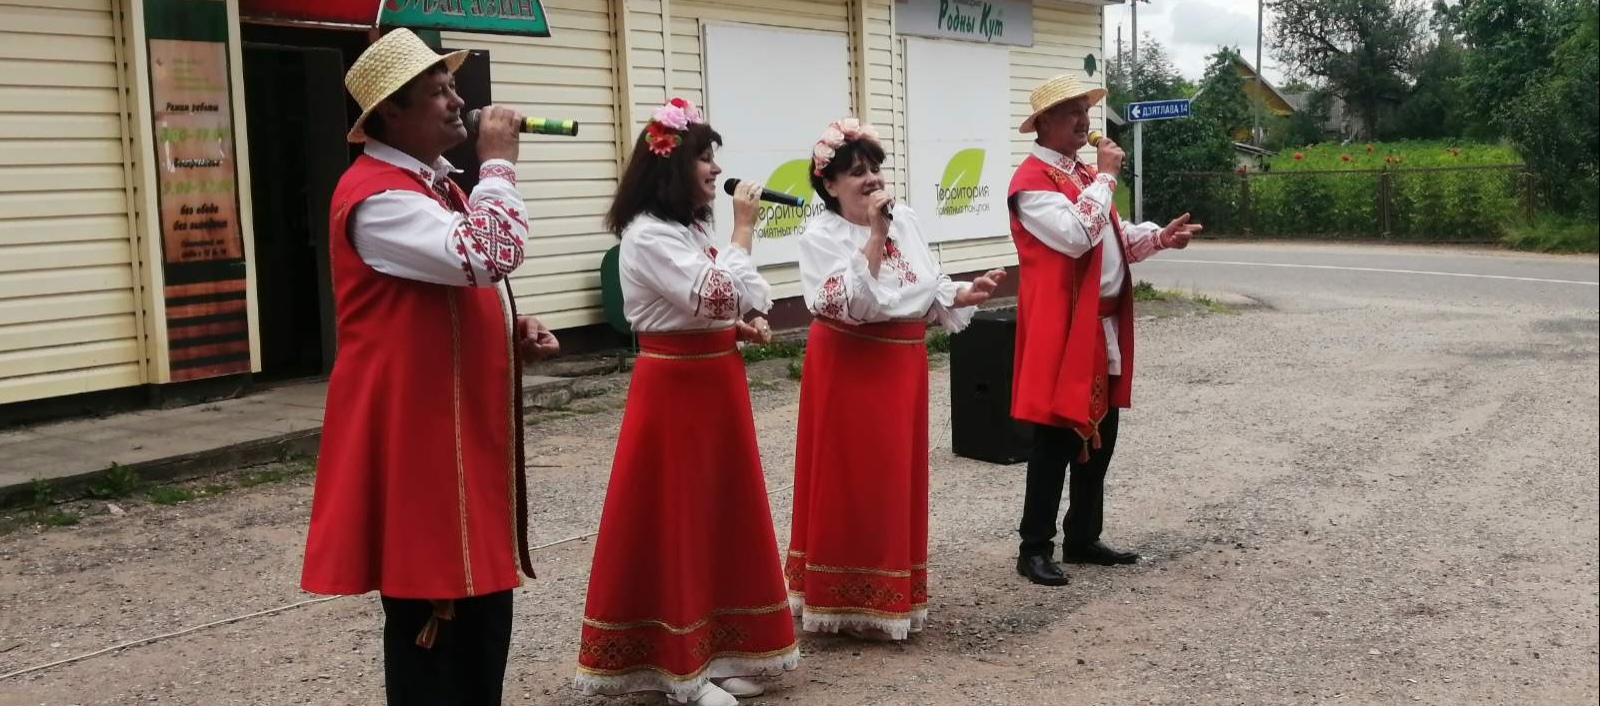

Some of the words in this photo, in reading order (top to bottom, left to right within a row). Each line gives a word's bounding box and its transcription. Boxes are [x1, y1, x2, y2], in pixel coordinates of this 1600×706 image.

[937, 0, 975, 33] Родны
[979, 2, 1004, 42] Кут
[1142, 105, 1179, 117] ДЗЯТЛАВА
[1181, 104, 1188, 113] 14
[935, 183, 990, 206] Территория
[758, 203, 827, 227] ерритория
